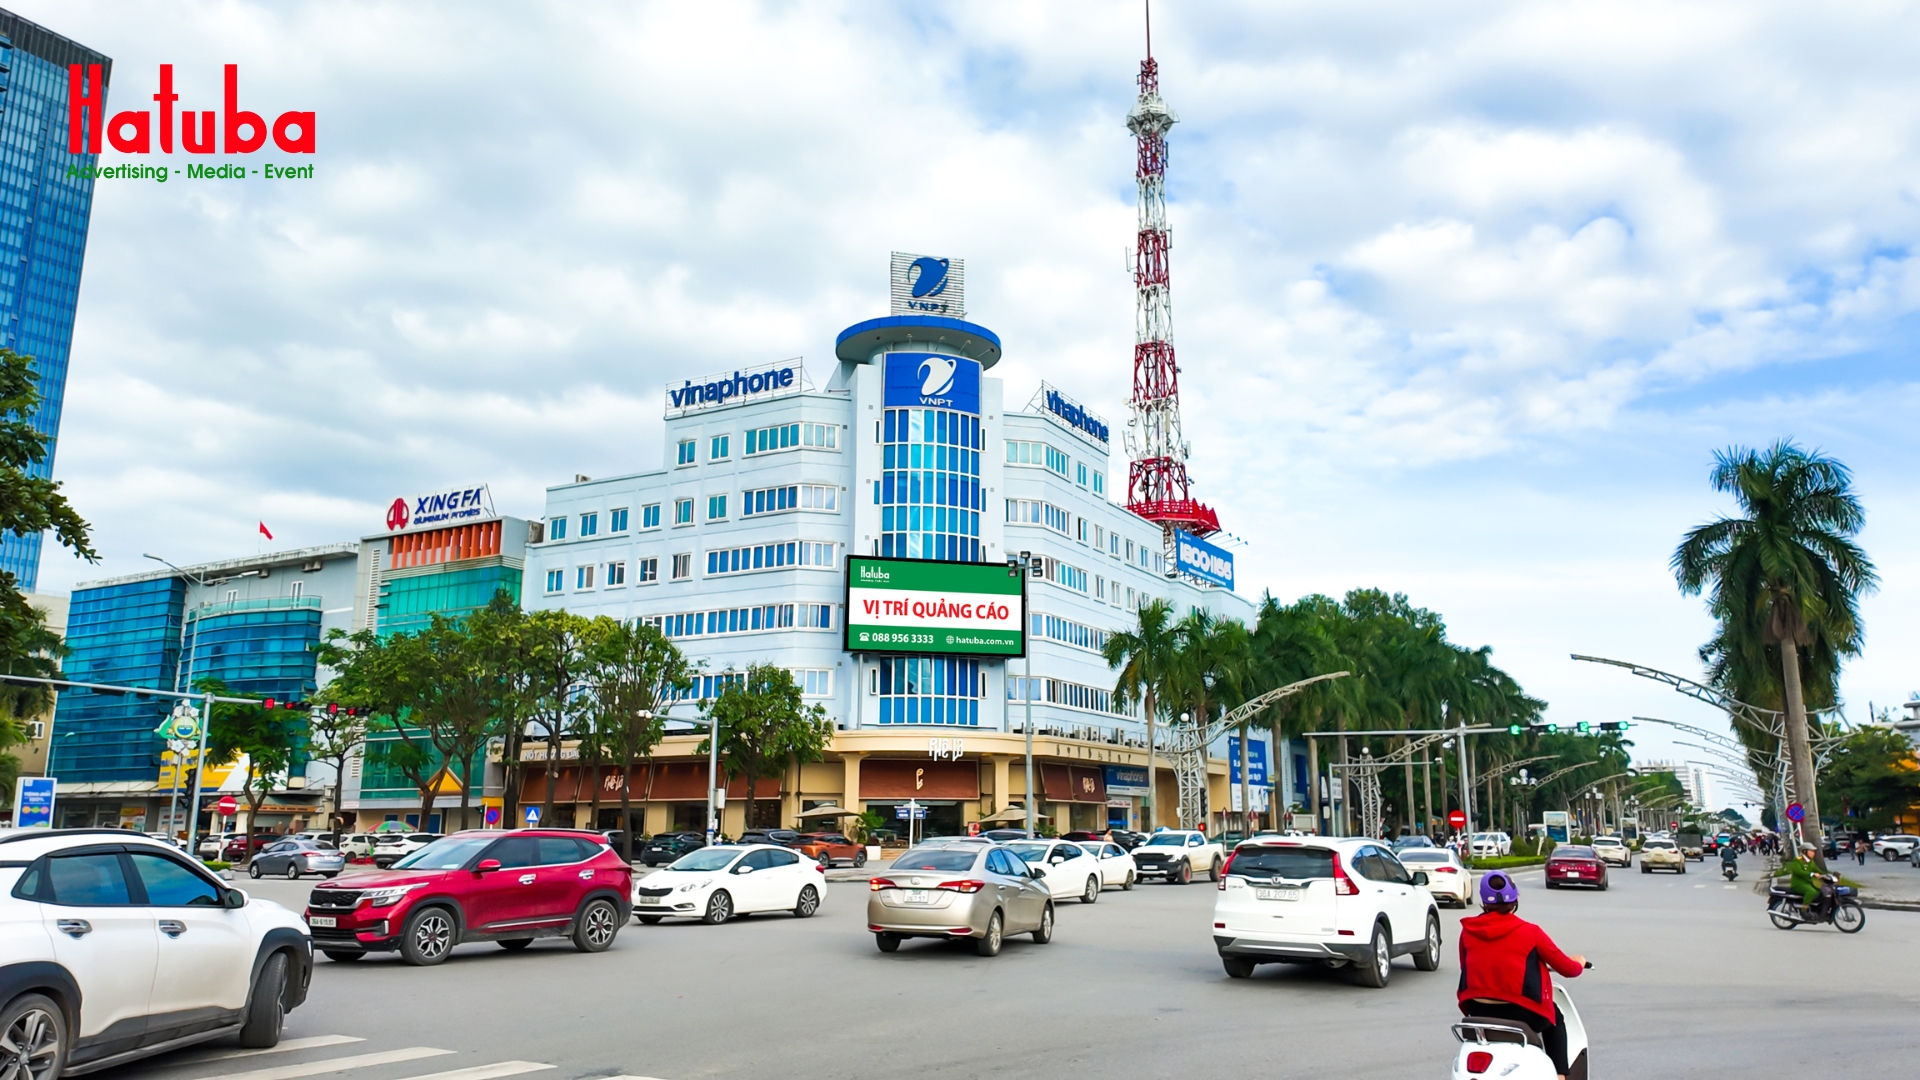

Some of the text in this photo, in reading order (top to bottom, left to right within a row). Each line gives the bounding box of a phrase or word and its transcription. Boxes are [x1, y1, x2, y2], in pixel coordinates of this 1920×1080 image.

[908, 300, 949, 313] VNPT
[670, 367, 794, 408] vinaphone
[919, 396, 954, 407] VNPT
[1046, 390, 1109, 443] vinaphone
[860, 565, 890, 579] Hatuba
[863, 598, 1009, 620] VỊ TRÍ QUẢNG CÁO
[872, 632, 1014, 646] 088 956 3333 hatuba.com.vn
